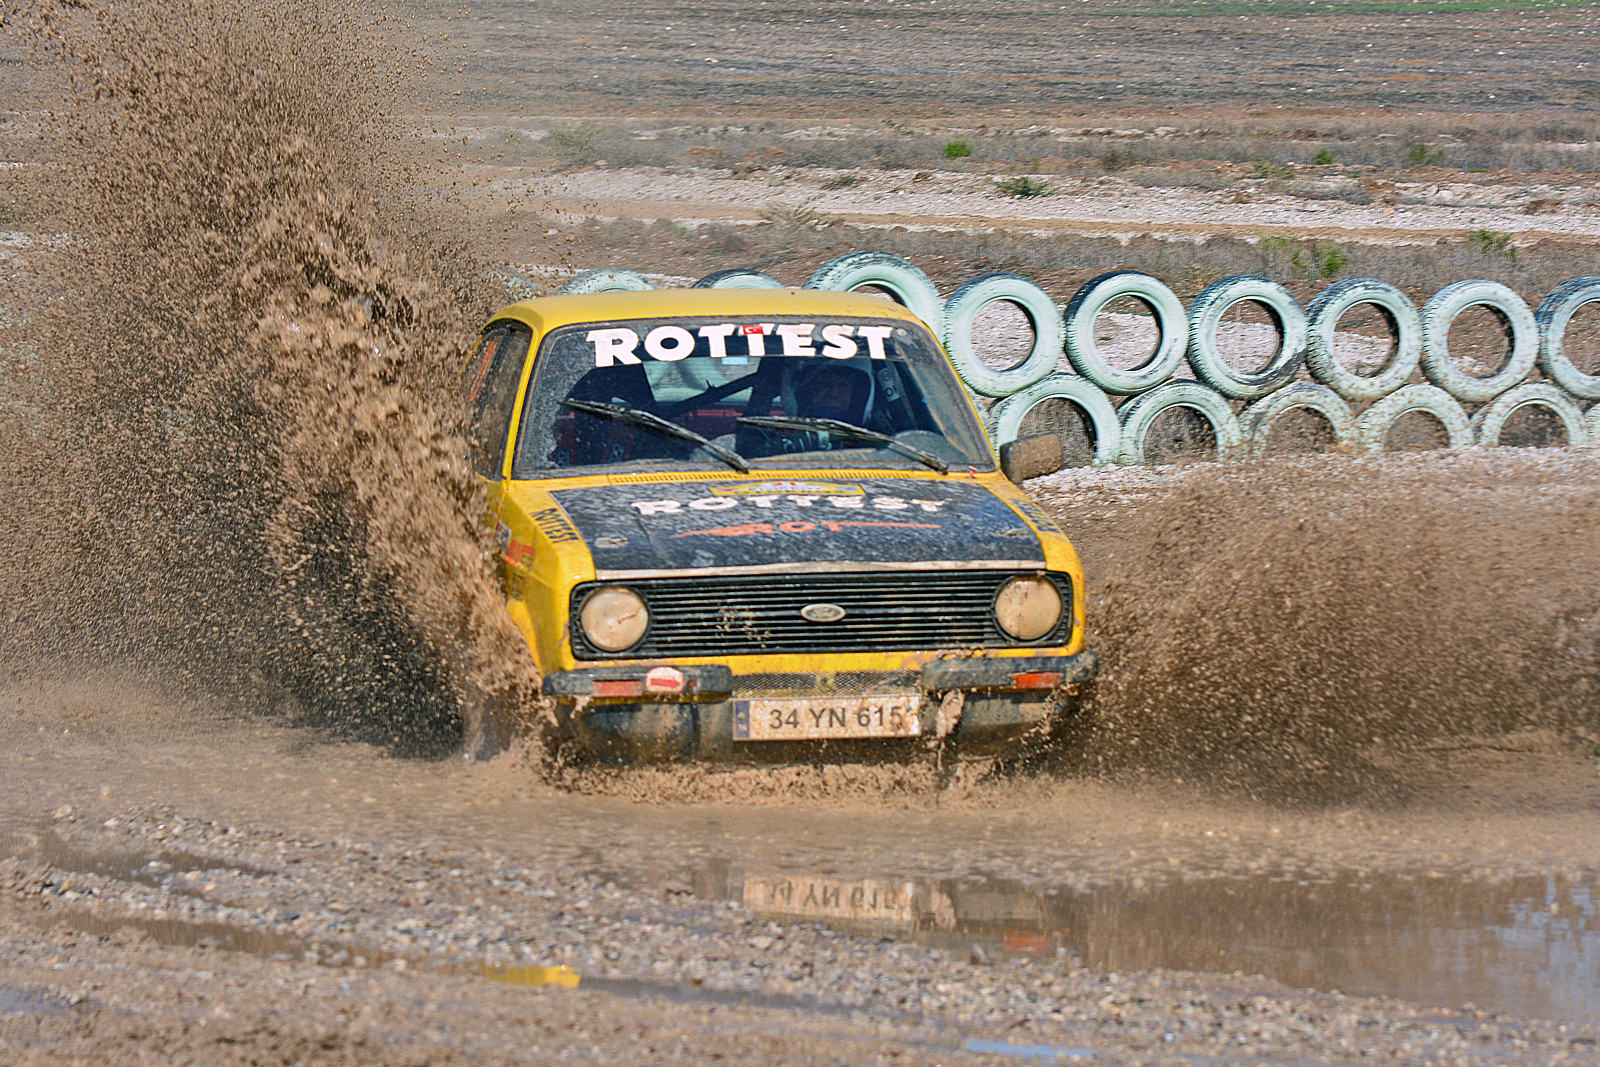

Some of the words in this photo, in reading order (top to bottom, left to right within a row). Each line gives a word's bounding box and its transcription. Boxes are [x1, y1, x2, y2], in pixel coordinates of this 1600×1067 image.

[585, 323, 893, 367] ROTTEST
[630, 495, 945, 515] ROTTEST
[769, 708, 799, 729] 34
[809, 707, 846, 728] YN
[857, 706, 903, 728] 615
